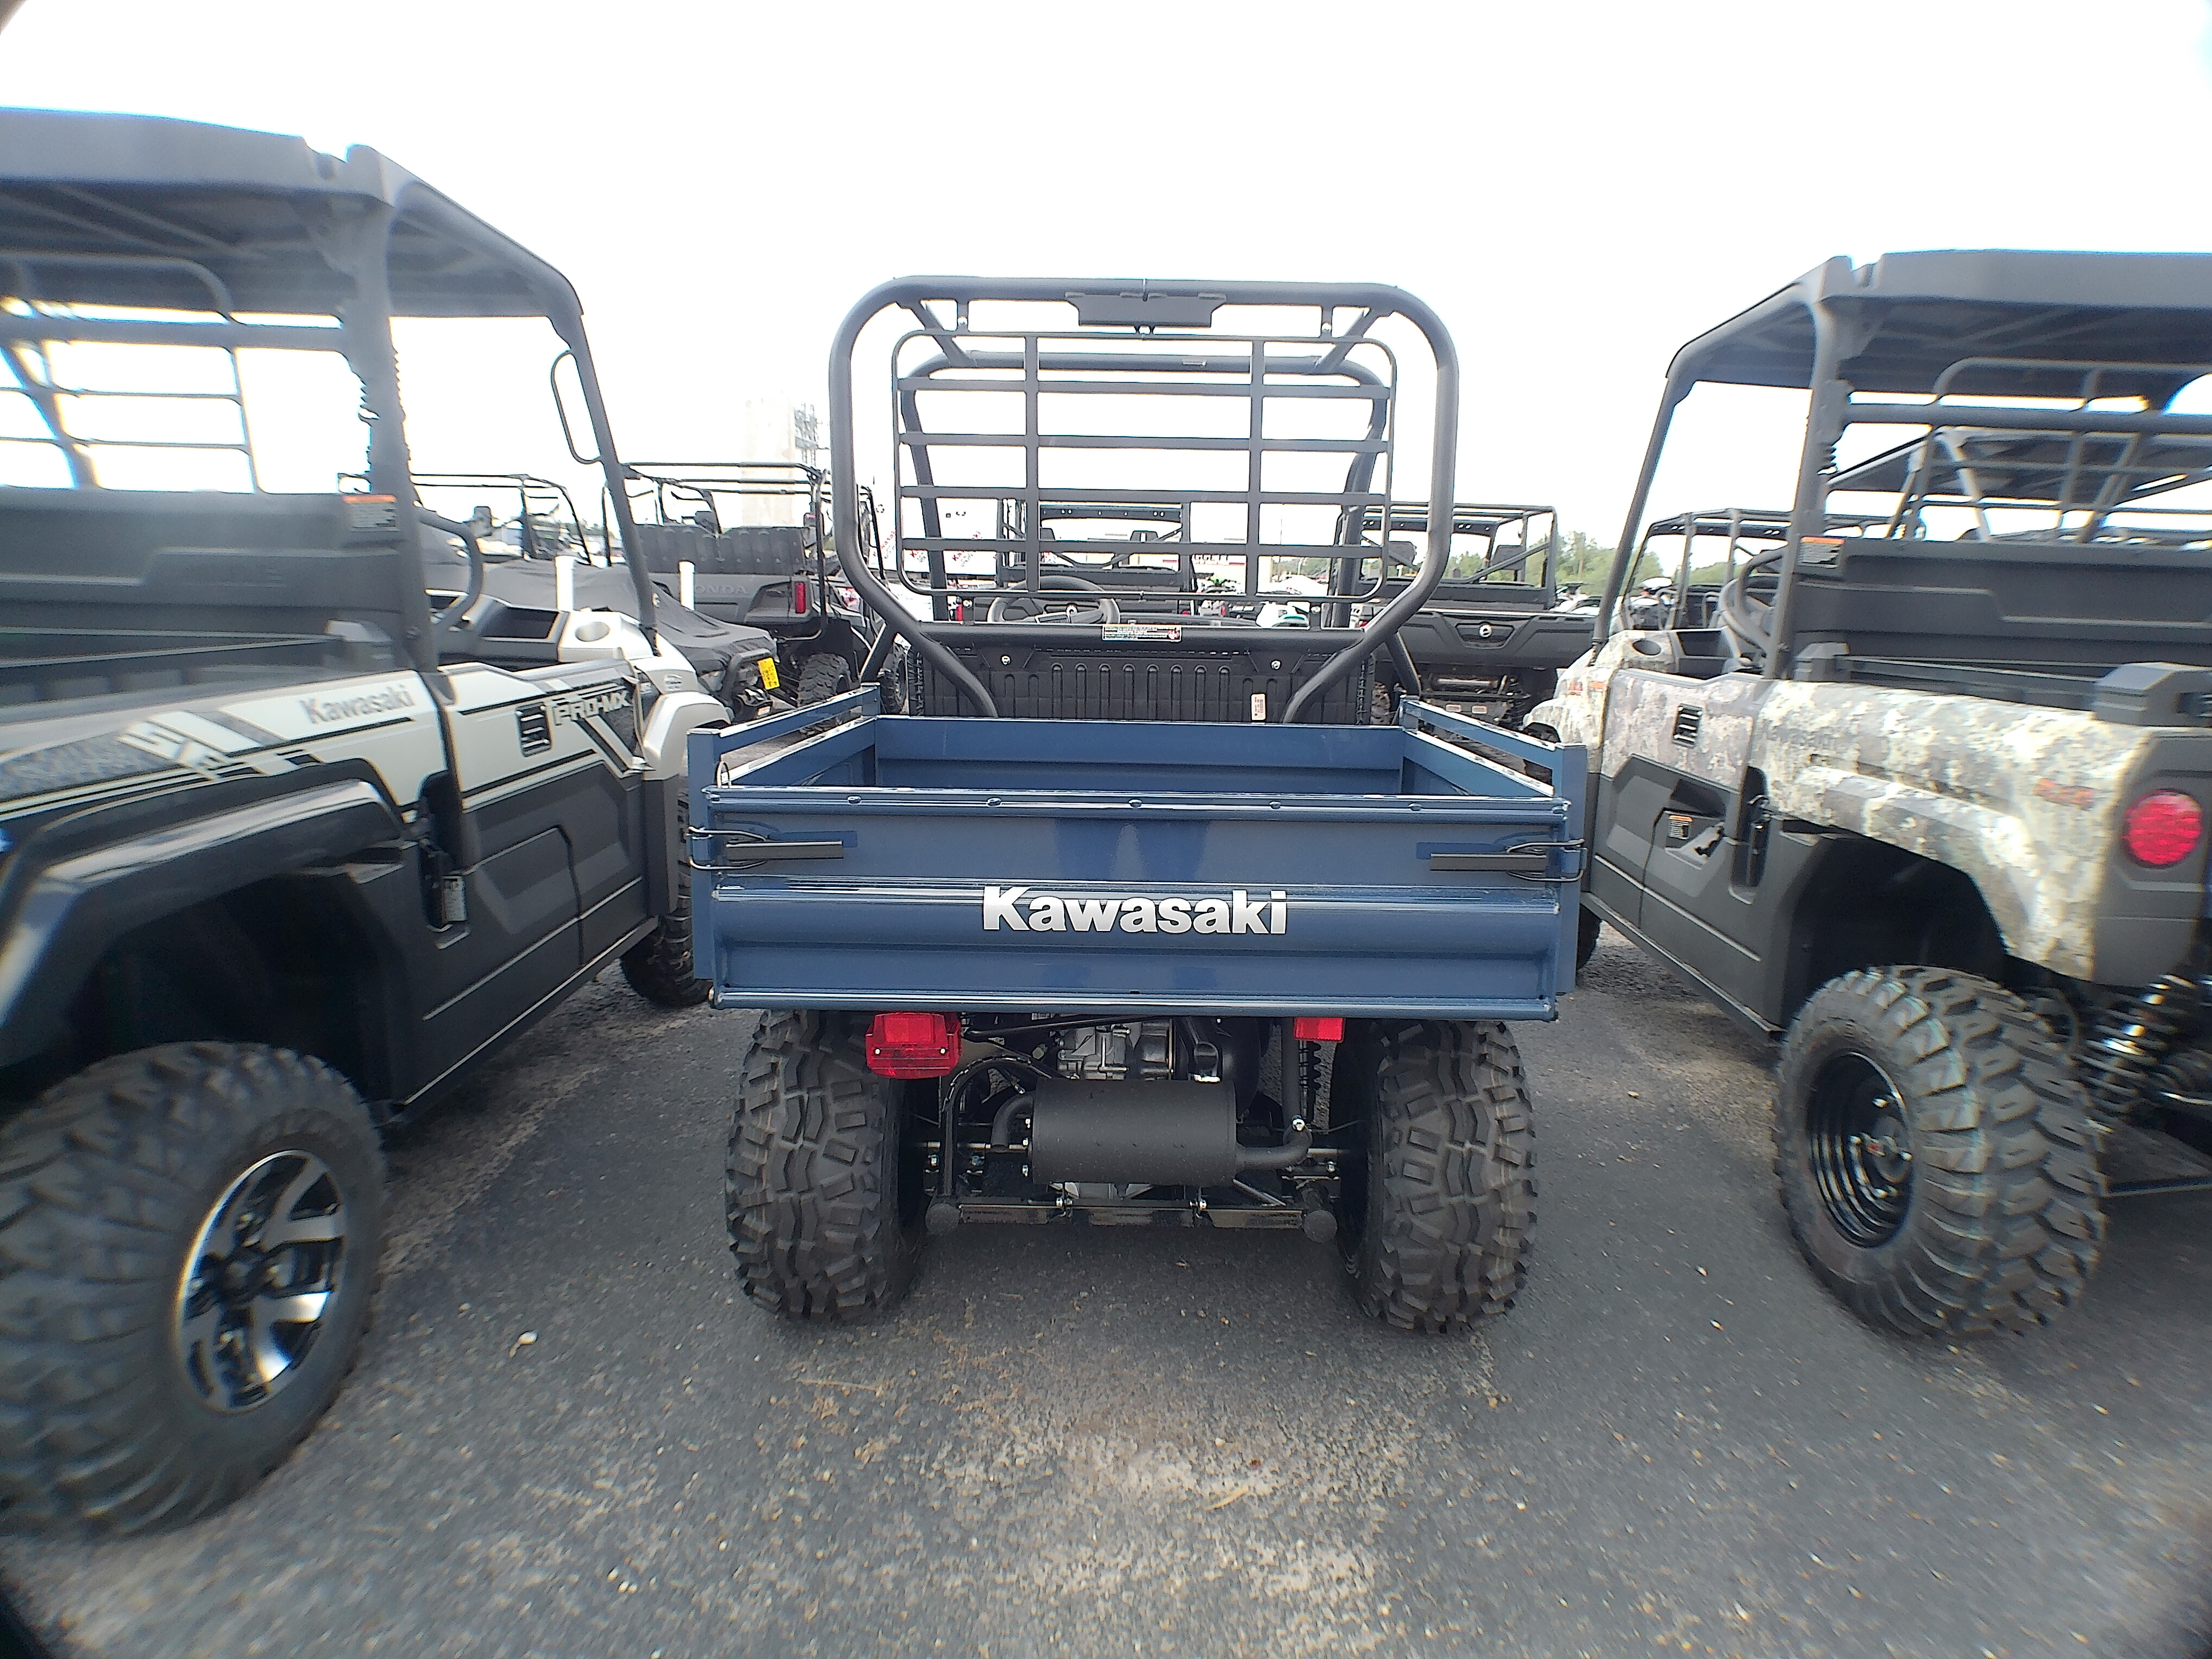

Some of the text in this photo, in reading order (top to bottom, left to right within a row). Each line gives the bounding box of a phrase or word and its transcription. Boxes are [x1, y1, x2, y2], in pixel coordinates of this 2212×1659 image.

[695, 585, 748, 594] ONDA
[299, 683, 416, 725] Kawasaki
[554, 690, 634, 726] PRO-MX
[983, 886, 1287, 934] Kawasaki
